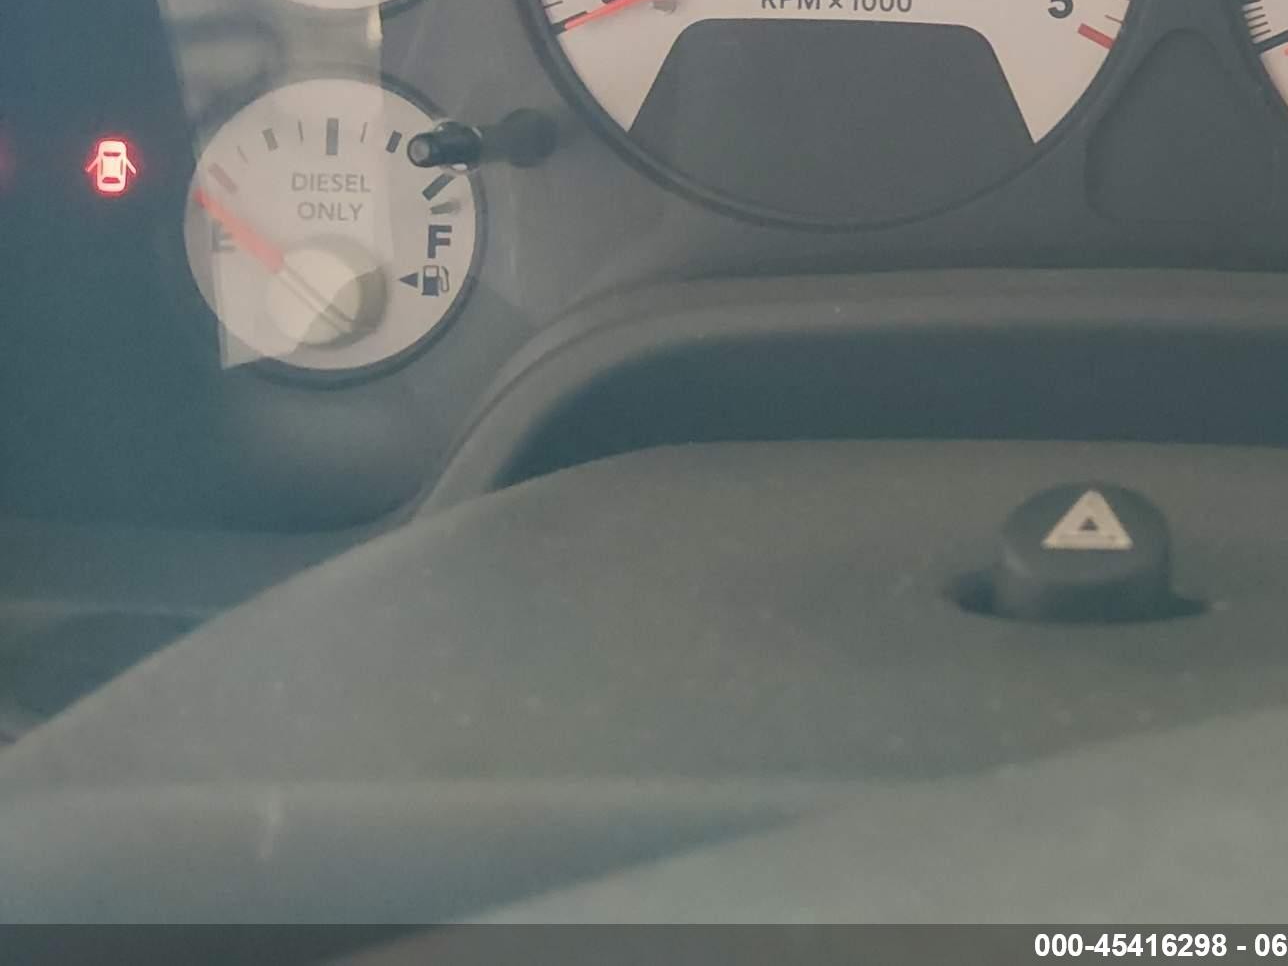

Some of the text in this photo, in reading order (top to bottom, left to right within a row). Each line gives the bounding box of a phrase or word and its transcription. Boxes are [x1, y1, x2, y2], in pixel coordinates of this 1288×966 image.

[291, 171, 372, 194] DIESEL
[297, 201, 364, 223] ONLY
[427, 224, 453, 258] F
